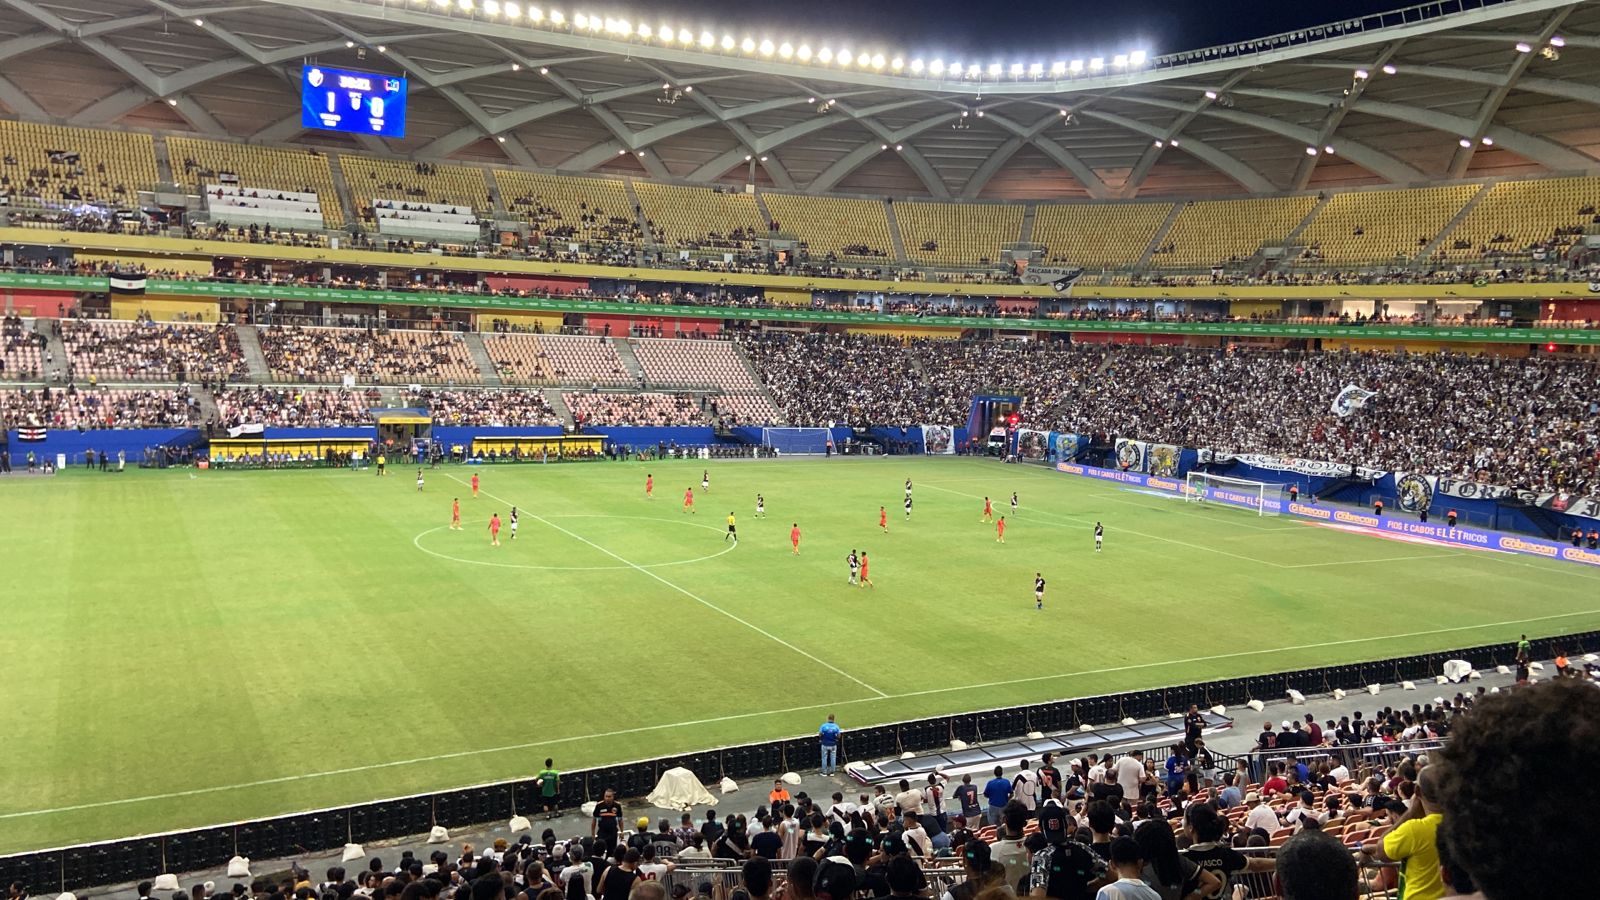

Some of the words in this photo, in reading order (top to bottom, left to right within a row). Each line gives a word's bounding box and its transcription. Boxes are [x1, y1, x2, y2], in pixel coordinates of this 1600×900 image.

[1387, 520, 1403, 530] FIOS
[1404, 523, 1409, 531] E
[1409, 525, 1435, 536] CABOS
[1437, 526, 1488, 543] ELÉTRICOS
